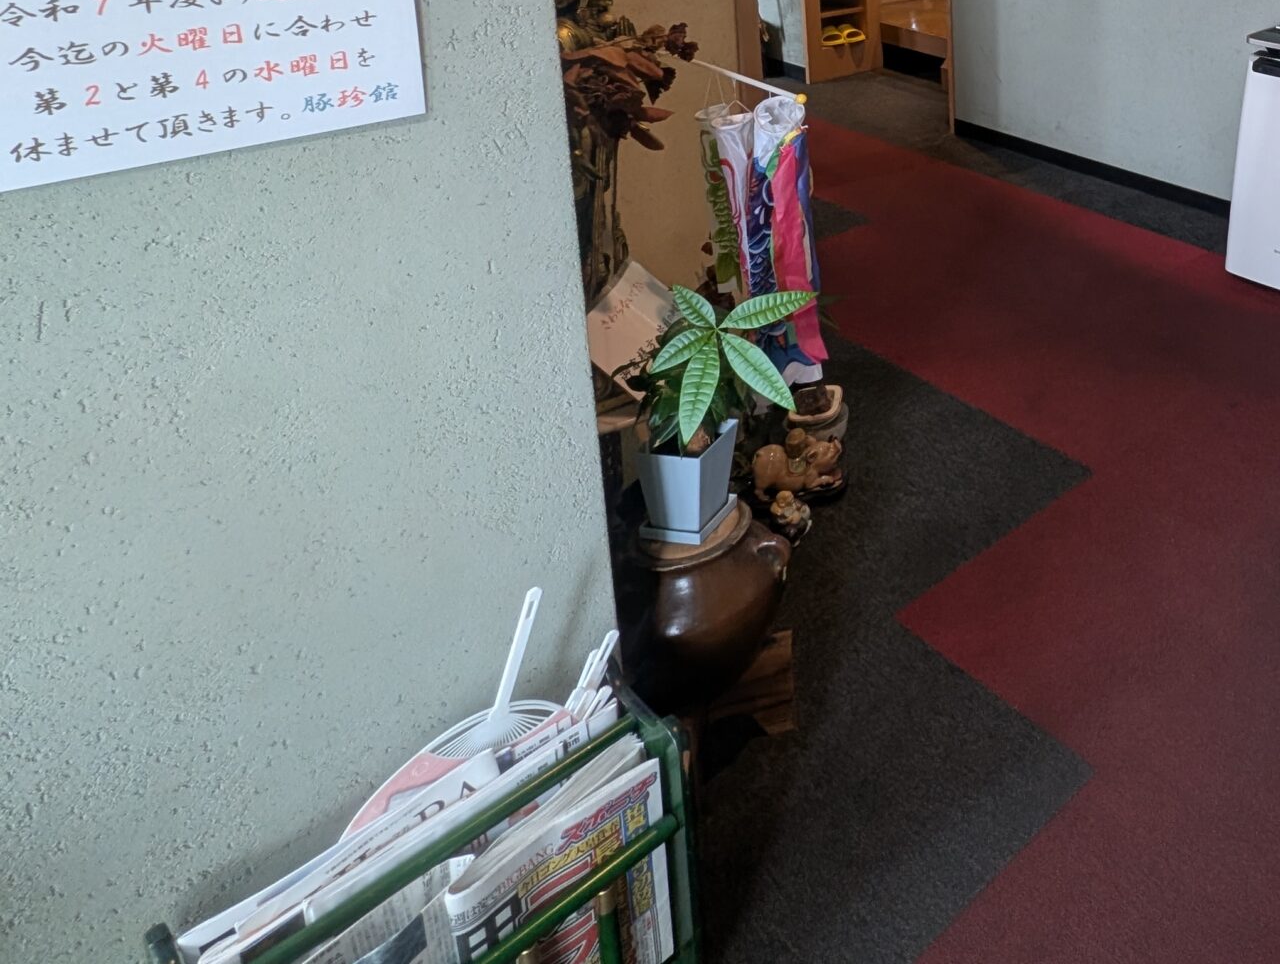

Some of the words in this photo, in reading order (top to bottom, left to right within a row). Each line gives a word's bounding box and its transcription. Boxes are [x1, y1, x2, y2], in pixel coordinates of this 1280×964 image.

[8, 10, 378, 73] 今迄の火曜日に合わせ
[9, 99, 293, 164] 休ませて頂きます。
[555, 771, 658, 856] スポニチ
